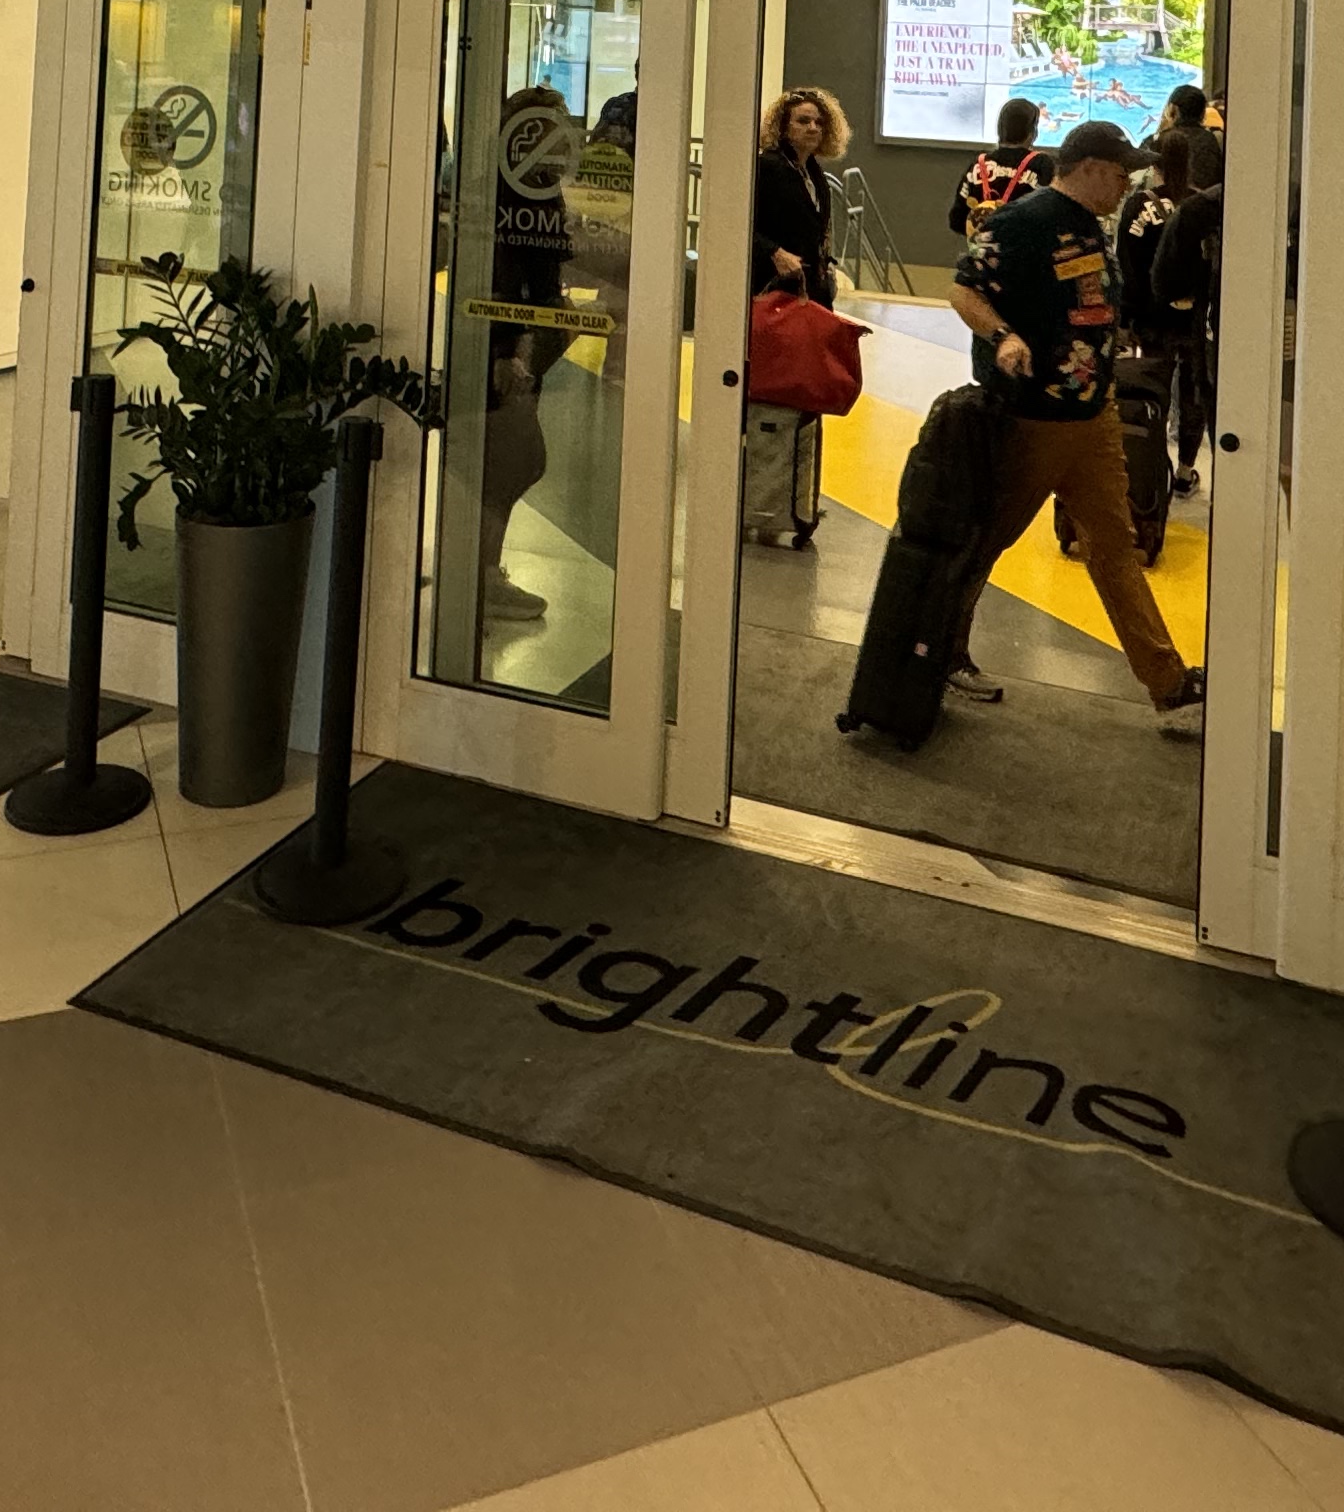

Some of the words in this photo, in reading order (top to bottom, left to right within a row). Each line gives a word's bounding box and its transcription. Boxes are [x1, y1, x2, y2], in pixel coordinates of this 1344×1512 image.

[896, 25, 971, 39] EXPERIENCE
[895, 40, 918, 53] THE
[894, 56, 922, 68] JUST
[926, 57, 934, 69] A
[938, 57, 975, 71] TRAIN
[468, 302, 512, 320] AUTOMATIC
[514, 308, 535, 321] DOOR
[554, 312, 580, 326] STAND
[582, 315, 608, 329] CLEAR
[363, 878, 1189, 1160] brightline
